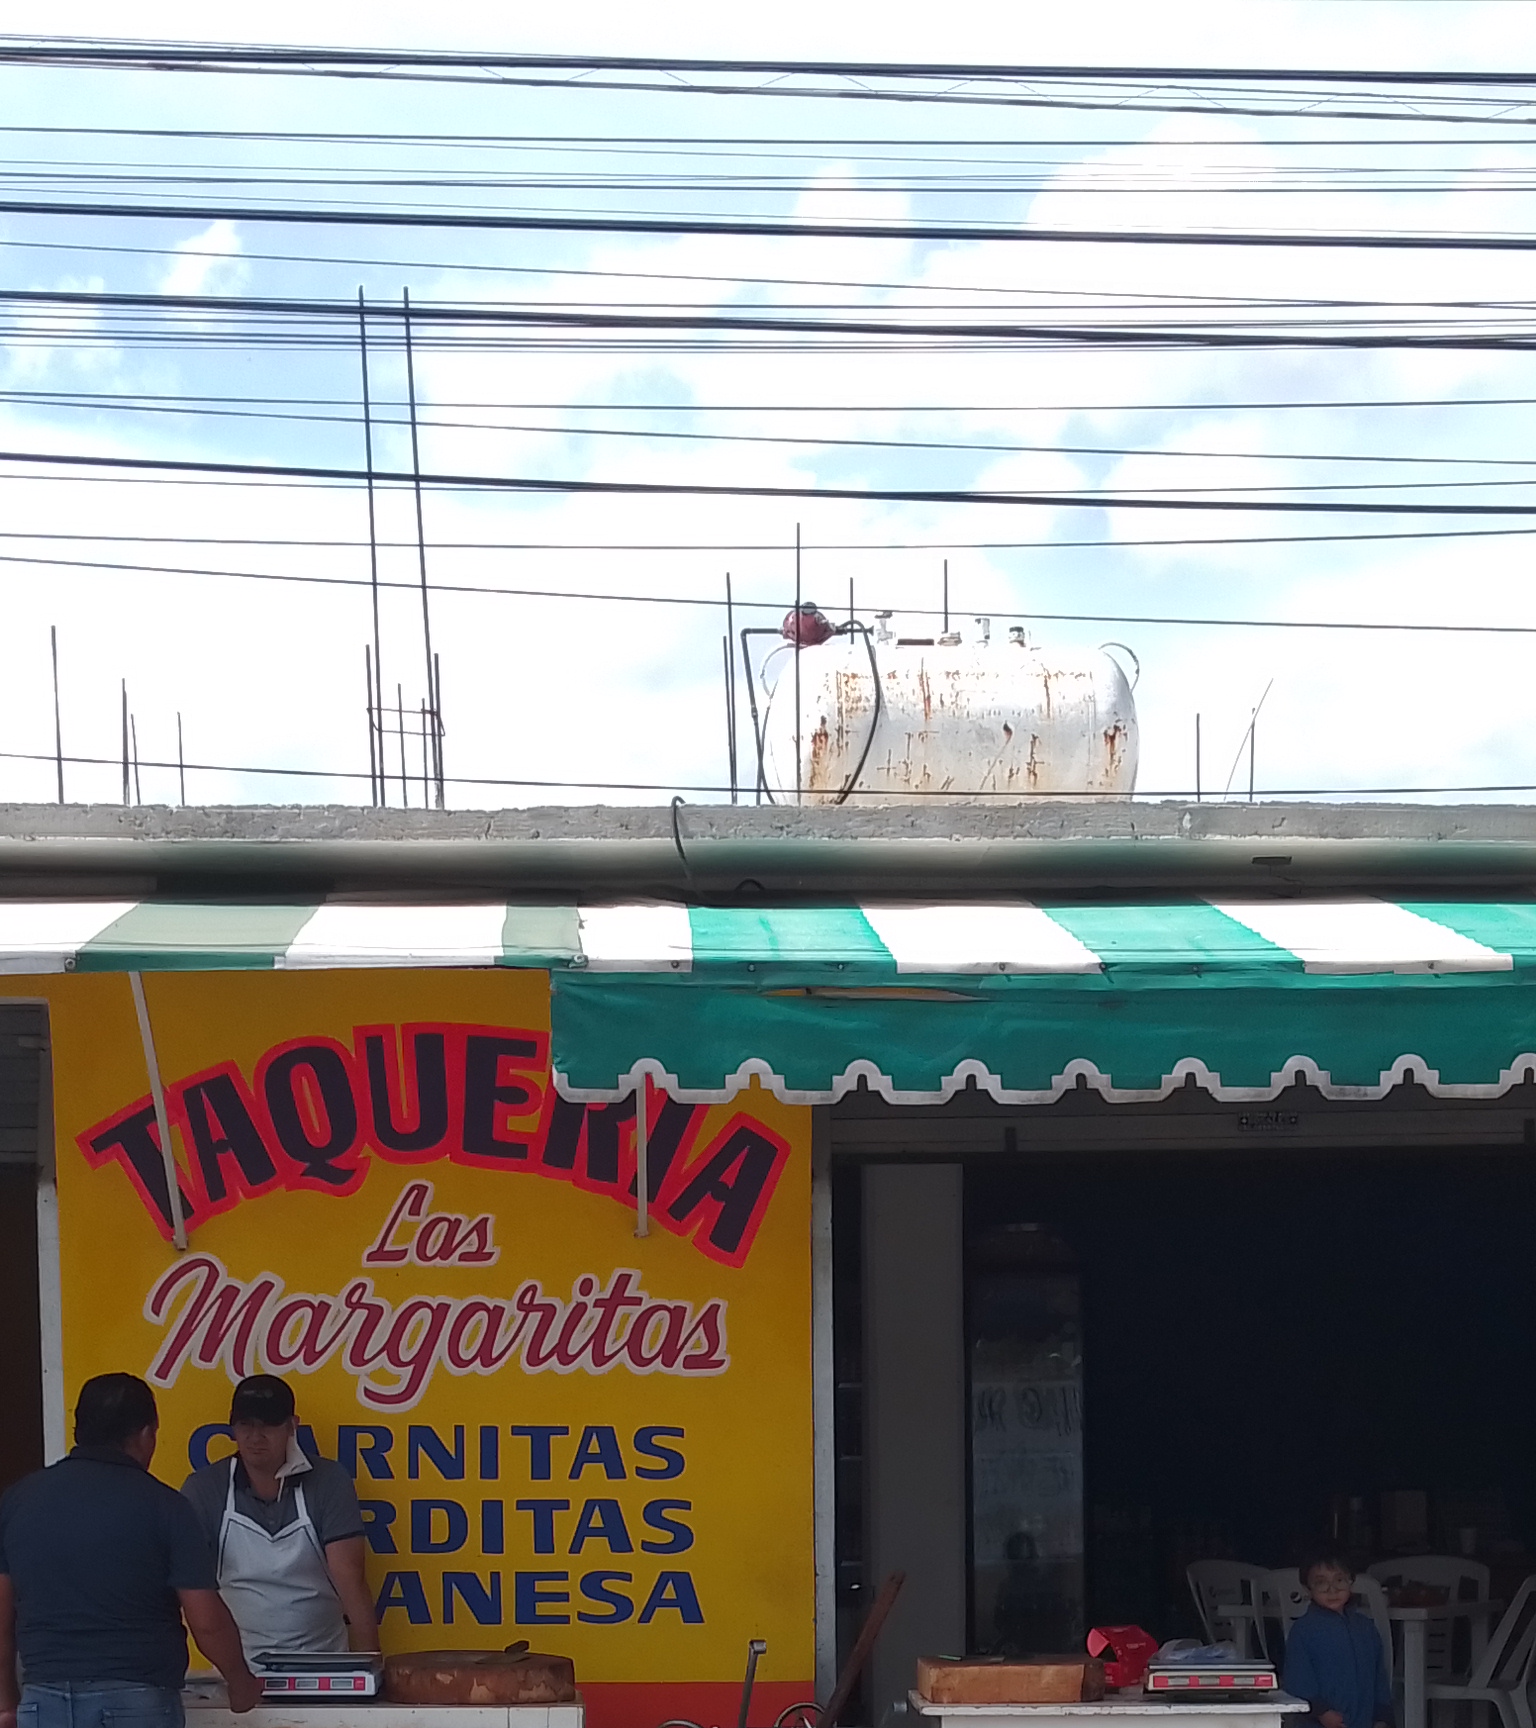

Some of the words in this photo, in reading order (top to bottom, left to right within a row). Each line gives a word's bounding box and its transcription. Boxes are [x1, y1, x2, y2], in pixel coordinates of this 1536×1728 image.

[365, 1180, 498, 1266] Las
[145, 1257, 731, 1411] Margaritas
[189, 1423, 687, 1480] CRNITAS
